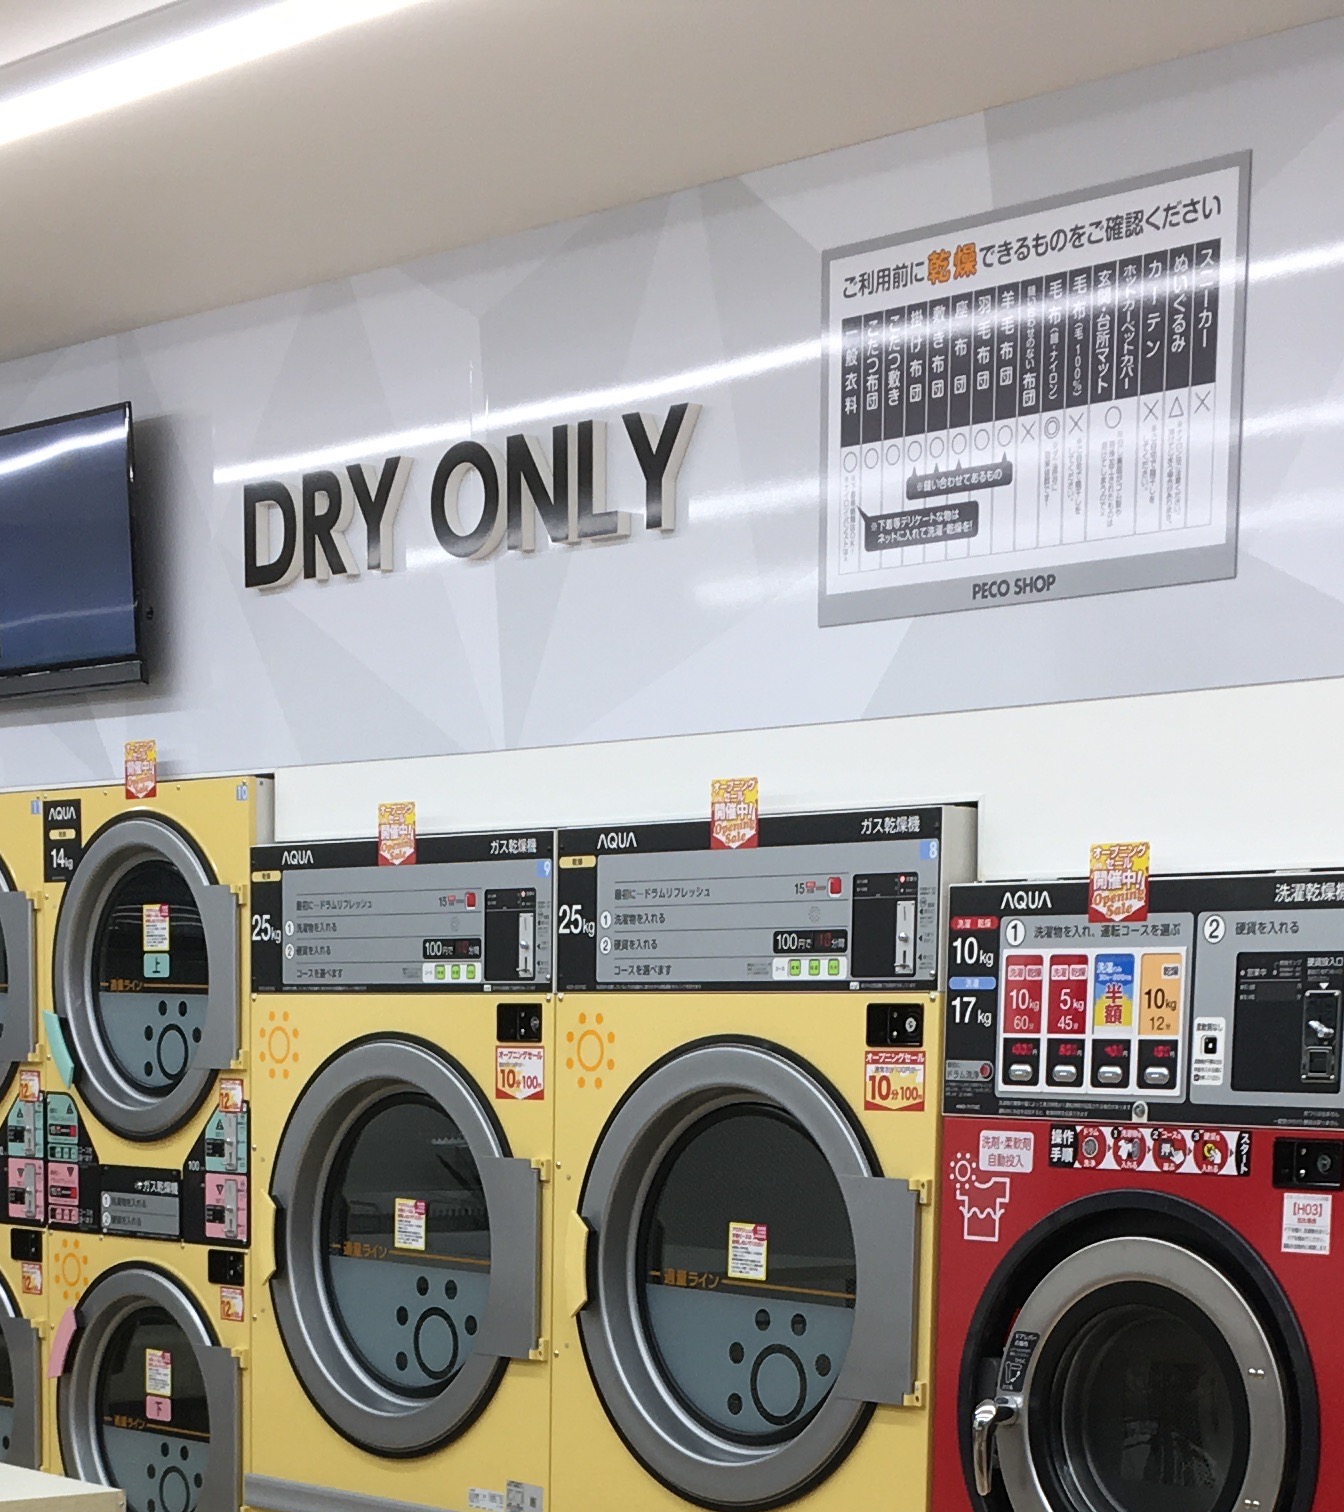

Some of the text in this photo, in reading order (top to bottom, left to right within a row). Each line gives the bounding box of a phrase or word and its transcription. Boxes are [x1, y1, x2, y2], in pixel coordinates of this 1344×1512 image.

[1145, 257, 1162, 358] カーテン
[1171, 253, 1190, 353] ぬいぐるみ
[1198, 247, 1215, 349] スニーカー
[931, 304, 945, 399] 敷き布団
[954, 300, 968, 395] 座布団
[976, 295, 991, 391] 羽毛布団
[999, 290, 1015, 387] 羊毛布団
[866, 318, 879, 411] こたつ布団
[887, 313, 900, 406] こたつ敷き
[909, 309, 923, 403] 掛け布団
[243, 454, 412, 589] DRY
[430, 402, 701, 561] ONLY
[972, 574, 1056, 600] PECO SHOP
[48, 806, 76, 820] AQUA
[861, 815, 920, 835] ガス乾燥機
[597, 832, 637, 849] AQUA
[929, 841, 938, 858] 8
[1092, 843, 1147, 859] オープニング
[282, 850, 314, 866] AQUA
[542, 862, 551, 876] 9
[1105, 857, 1133, 870] セール
[1000, 891, 1052, 910] AQUA
[1092, 888, 1146, 906] Opening
[1106, 901, 1133, 919] Sale
[558, 904, 595, 937] 25kg
[952, 937, 994, 966] 10kg
[951, 996, 992, 1027] 17kg
